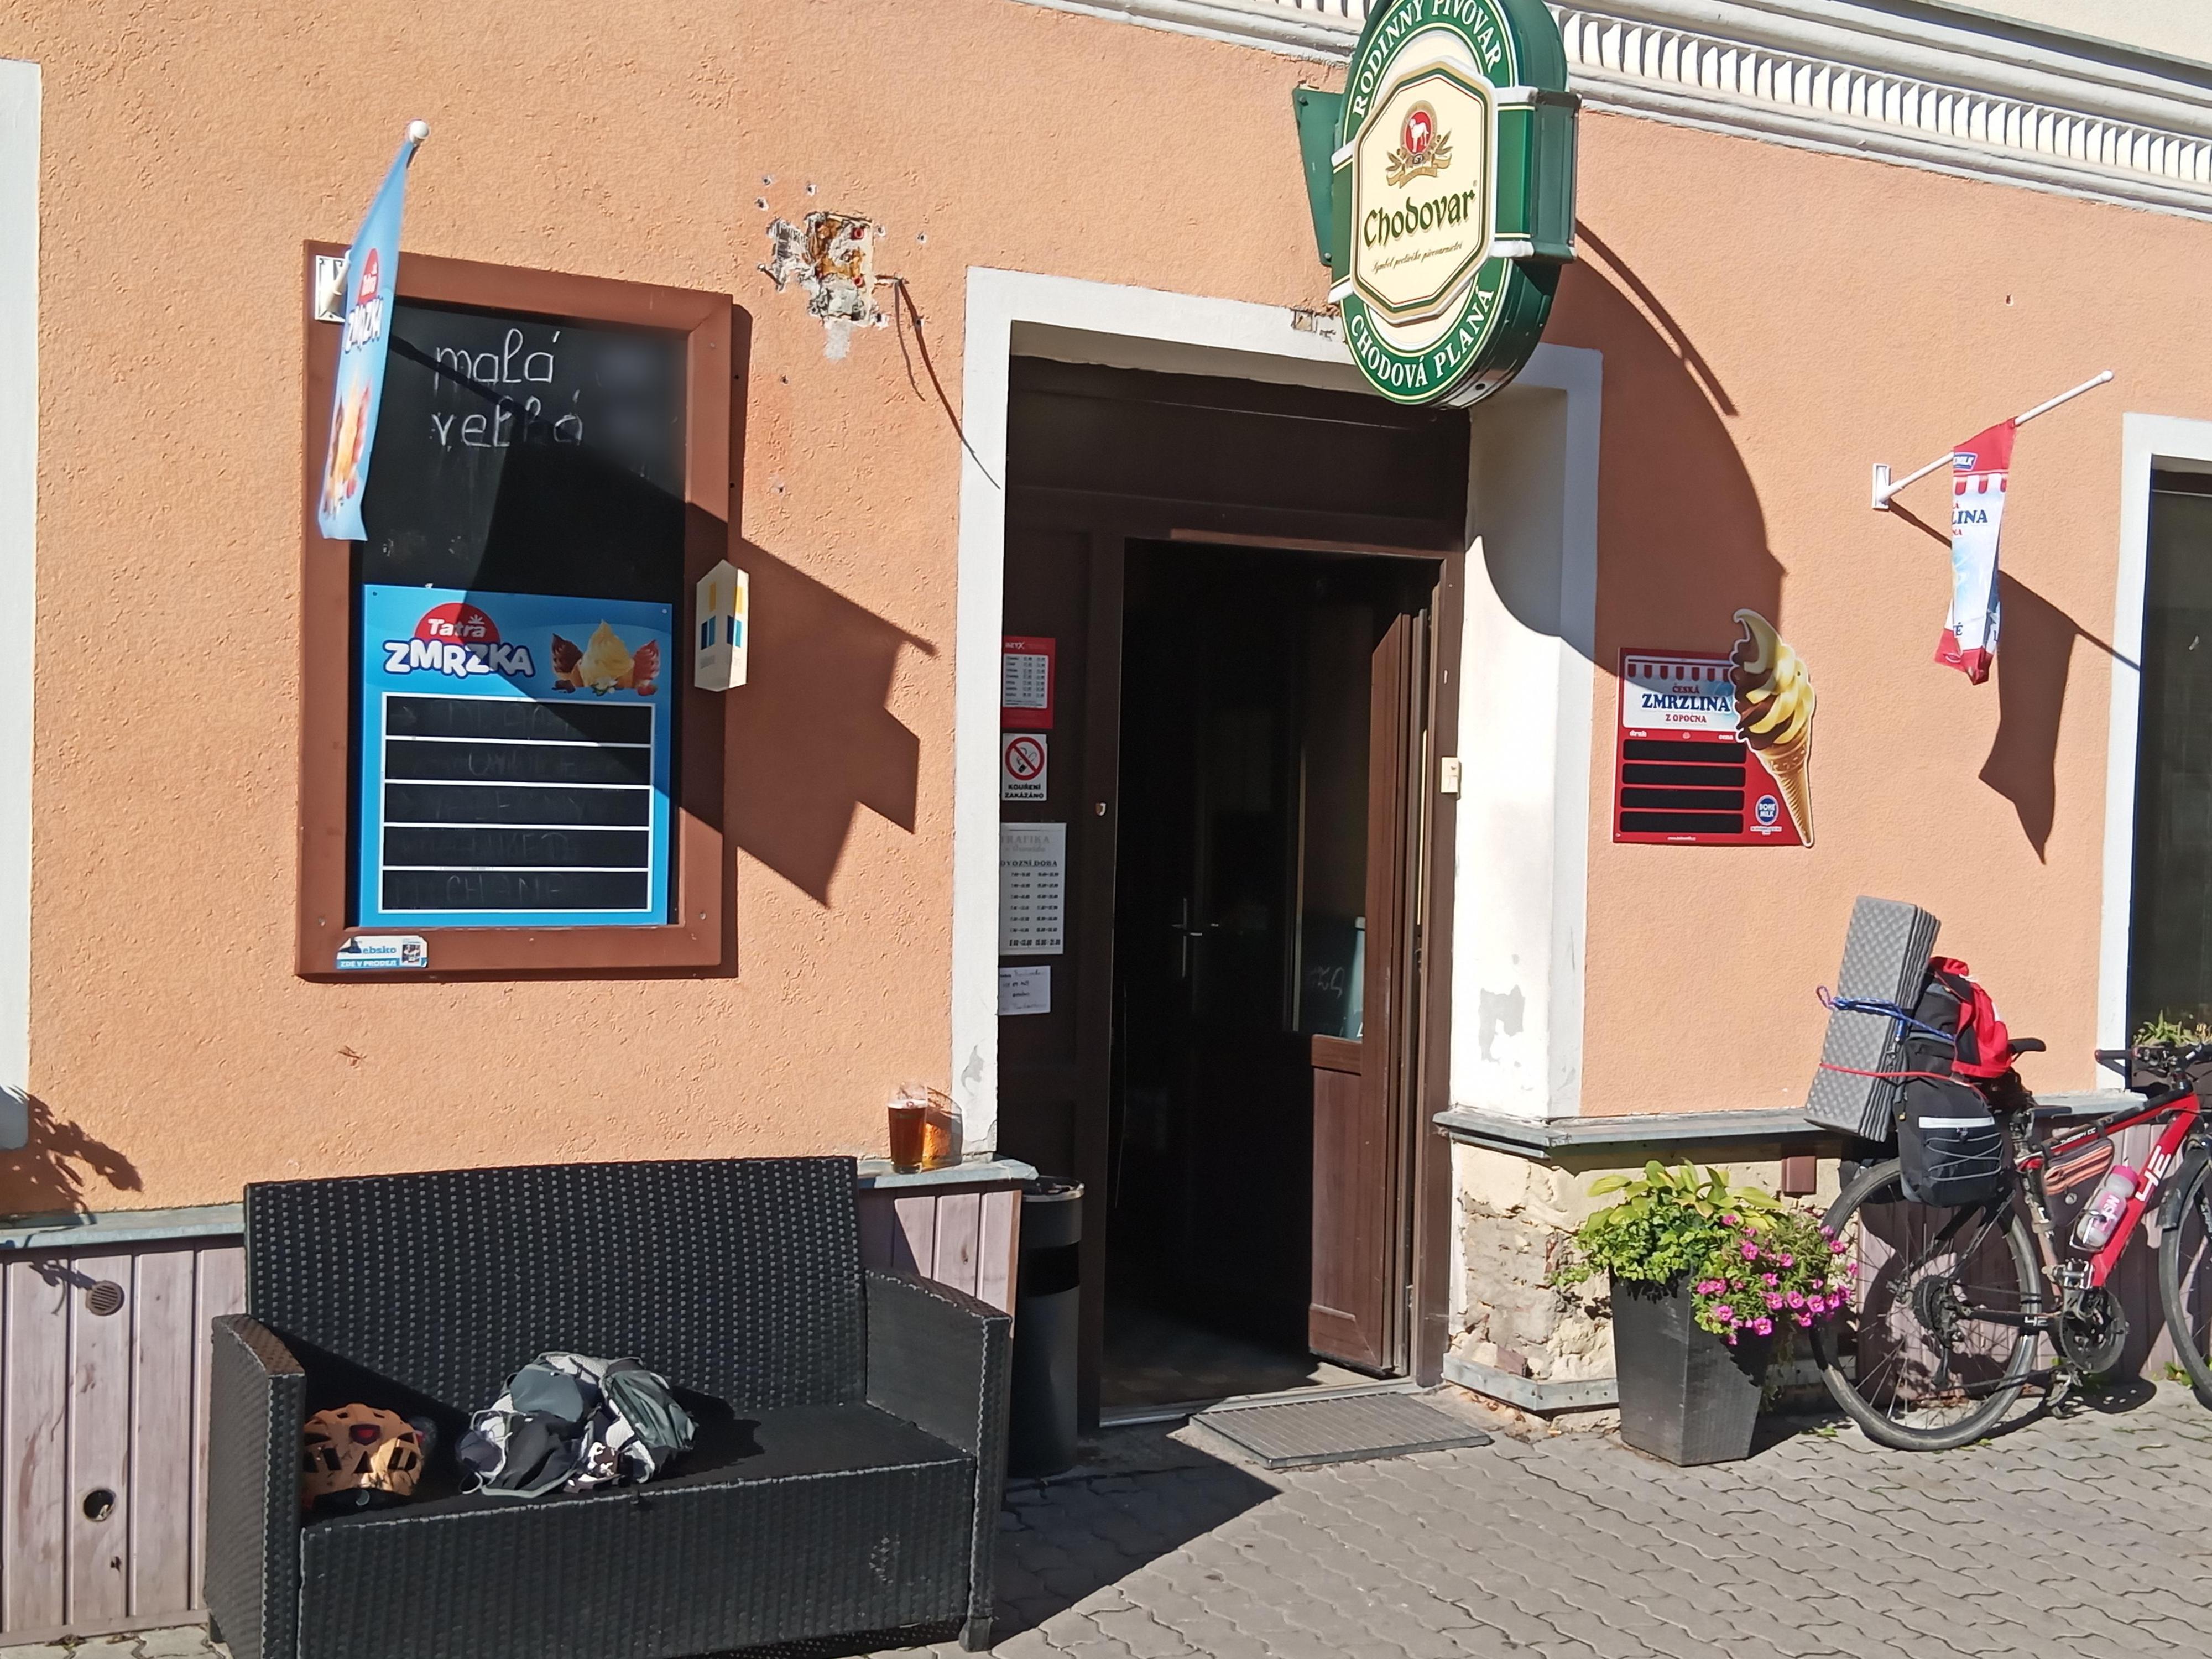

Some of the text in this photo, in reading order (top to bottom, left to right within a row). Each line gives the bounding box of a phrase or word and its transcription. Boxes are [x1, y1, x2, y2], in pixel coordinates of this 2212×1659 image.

[1364, 190, 1475, 247] Chodovar
[1351, 285, 1494, 388] CHODOVÁ PLANÁ
[434, 328, 560, 390] malá
[427, 618, 486, 638] Tatra
[384, 639, 535, 678] ZMRZKA
[1642, 693, 1730, 712] ZMRZLINA
[1672, 684, 1700, 694] ČESKÁ
